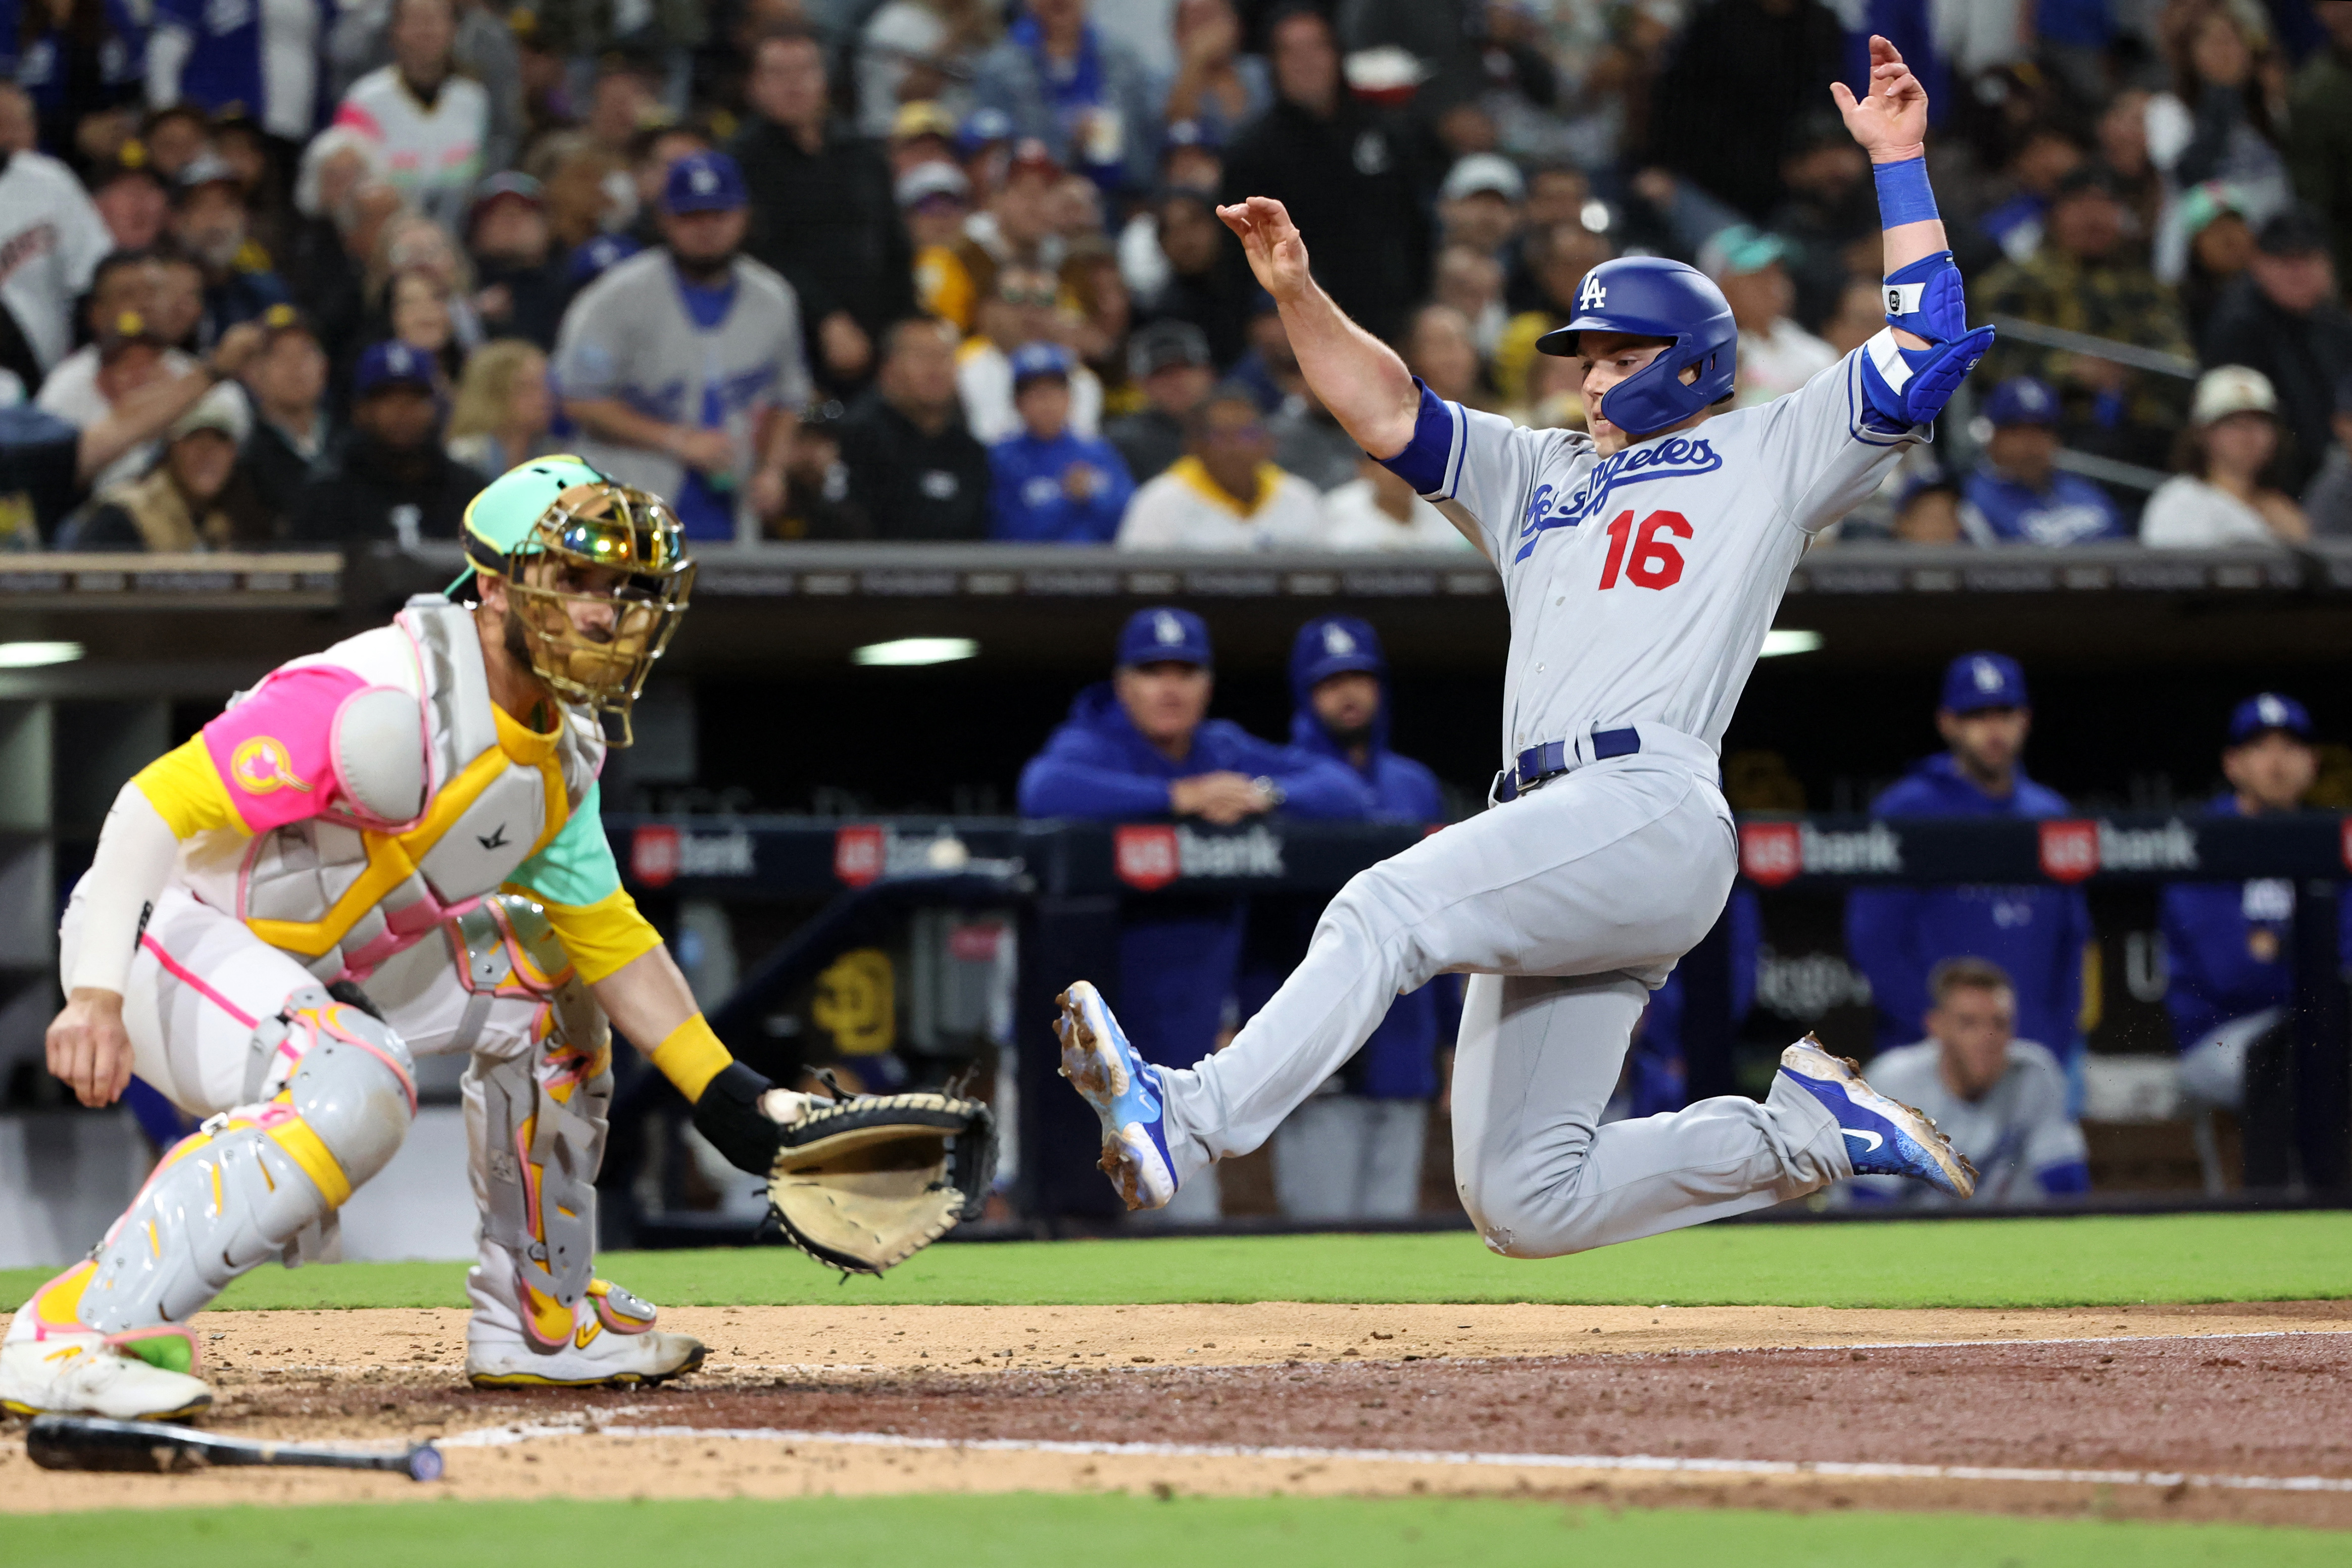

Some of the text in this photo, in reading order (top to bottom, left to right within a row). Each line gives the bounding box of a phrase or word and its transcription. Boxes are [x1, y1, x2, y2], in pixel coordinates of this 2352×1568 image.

[1580, 271, 1606, 311] LA
[1598, 510, 1694, 591] 16
[1175, 824, 1286, 877] bank
[1799, 821, 1902, 874] bank
[2096, 818, 2199, 871] bank
